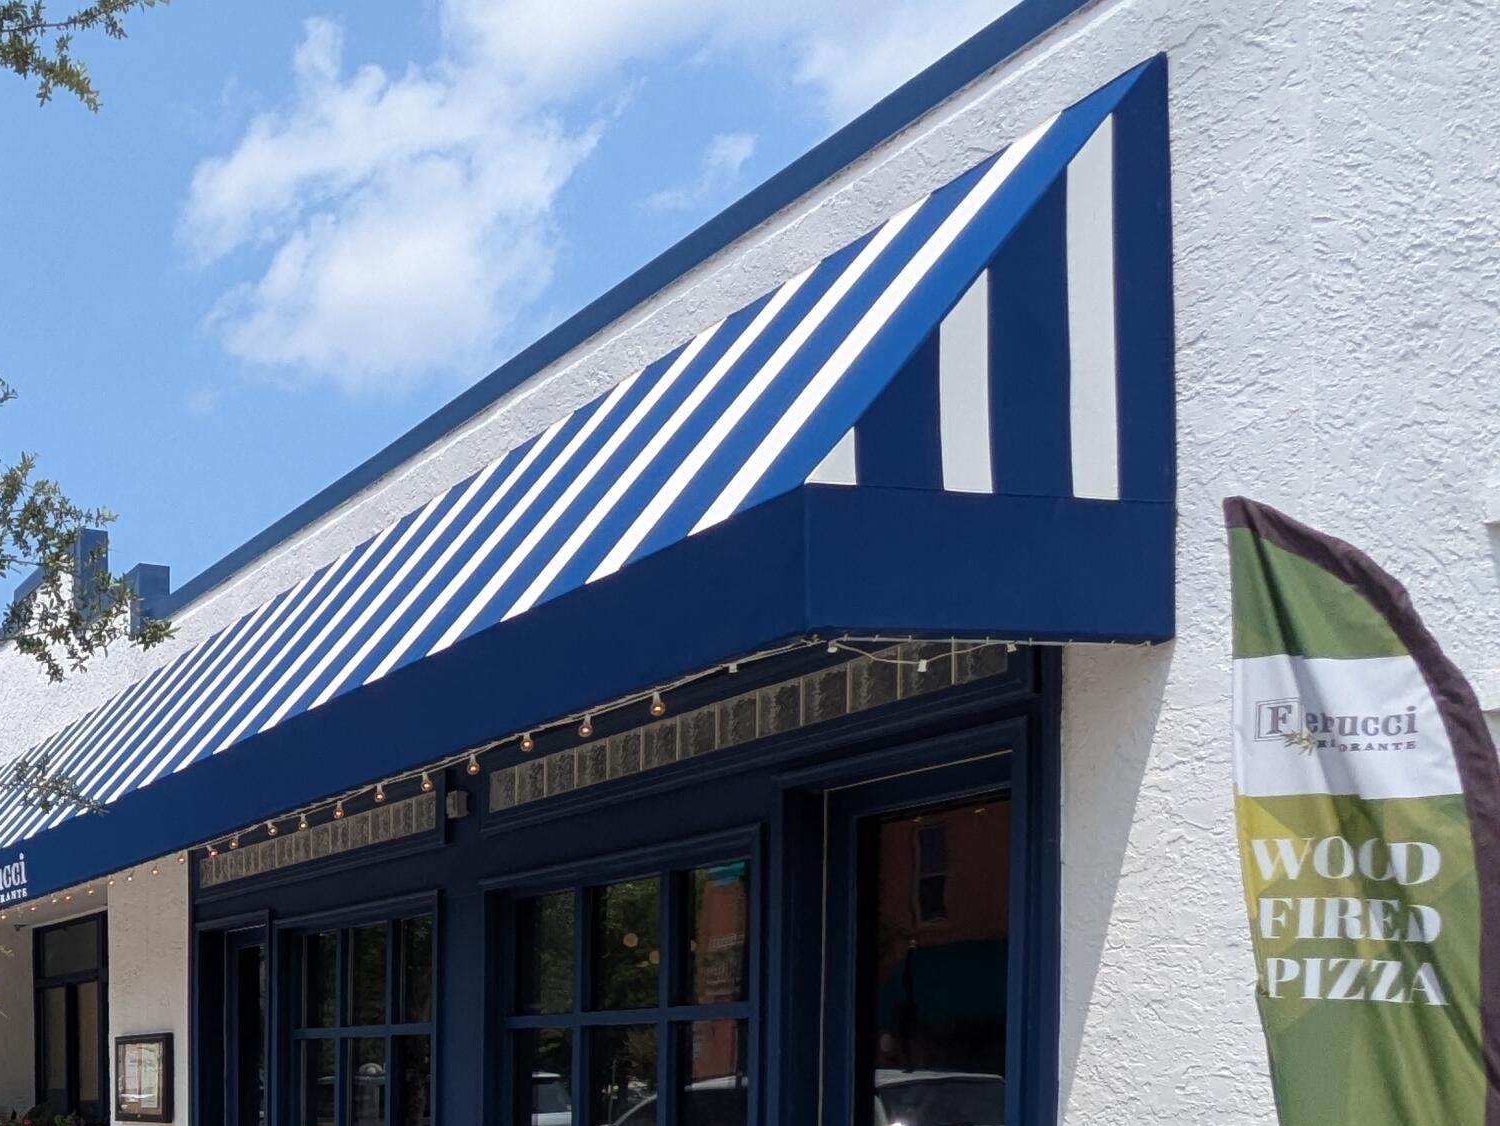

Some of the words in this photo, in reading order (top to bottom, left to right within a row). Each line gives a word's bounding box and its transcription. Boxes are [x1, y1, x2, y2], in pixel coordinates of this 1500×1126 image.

[1251, 835, 1442, 886] WOOD
[1258, 896, 1442, 944] FIRED
[1266, 957, 1451, 1006] PIZZA
